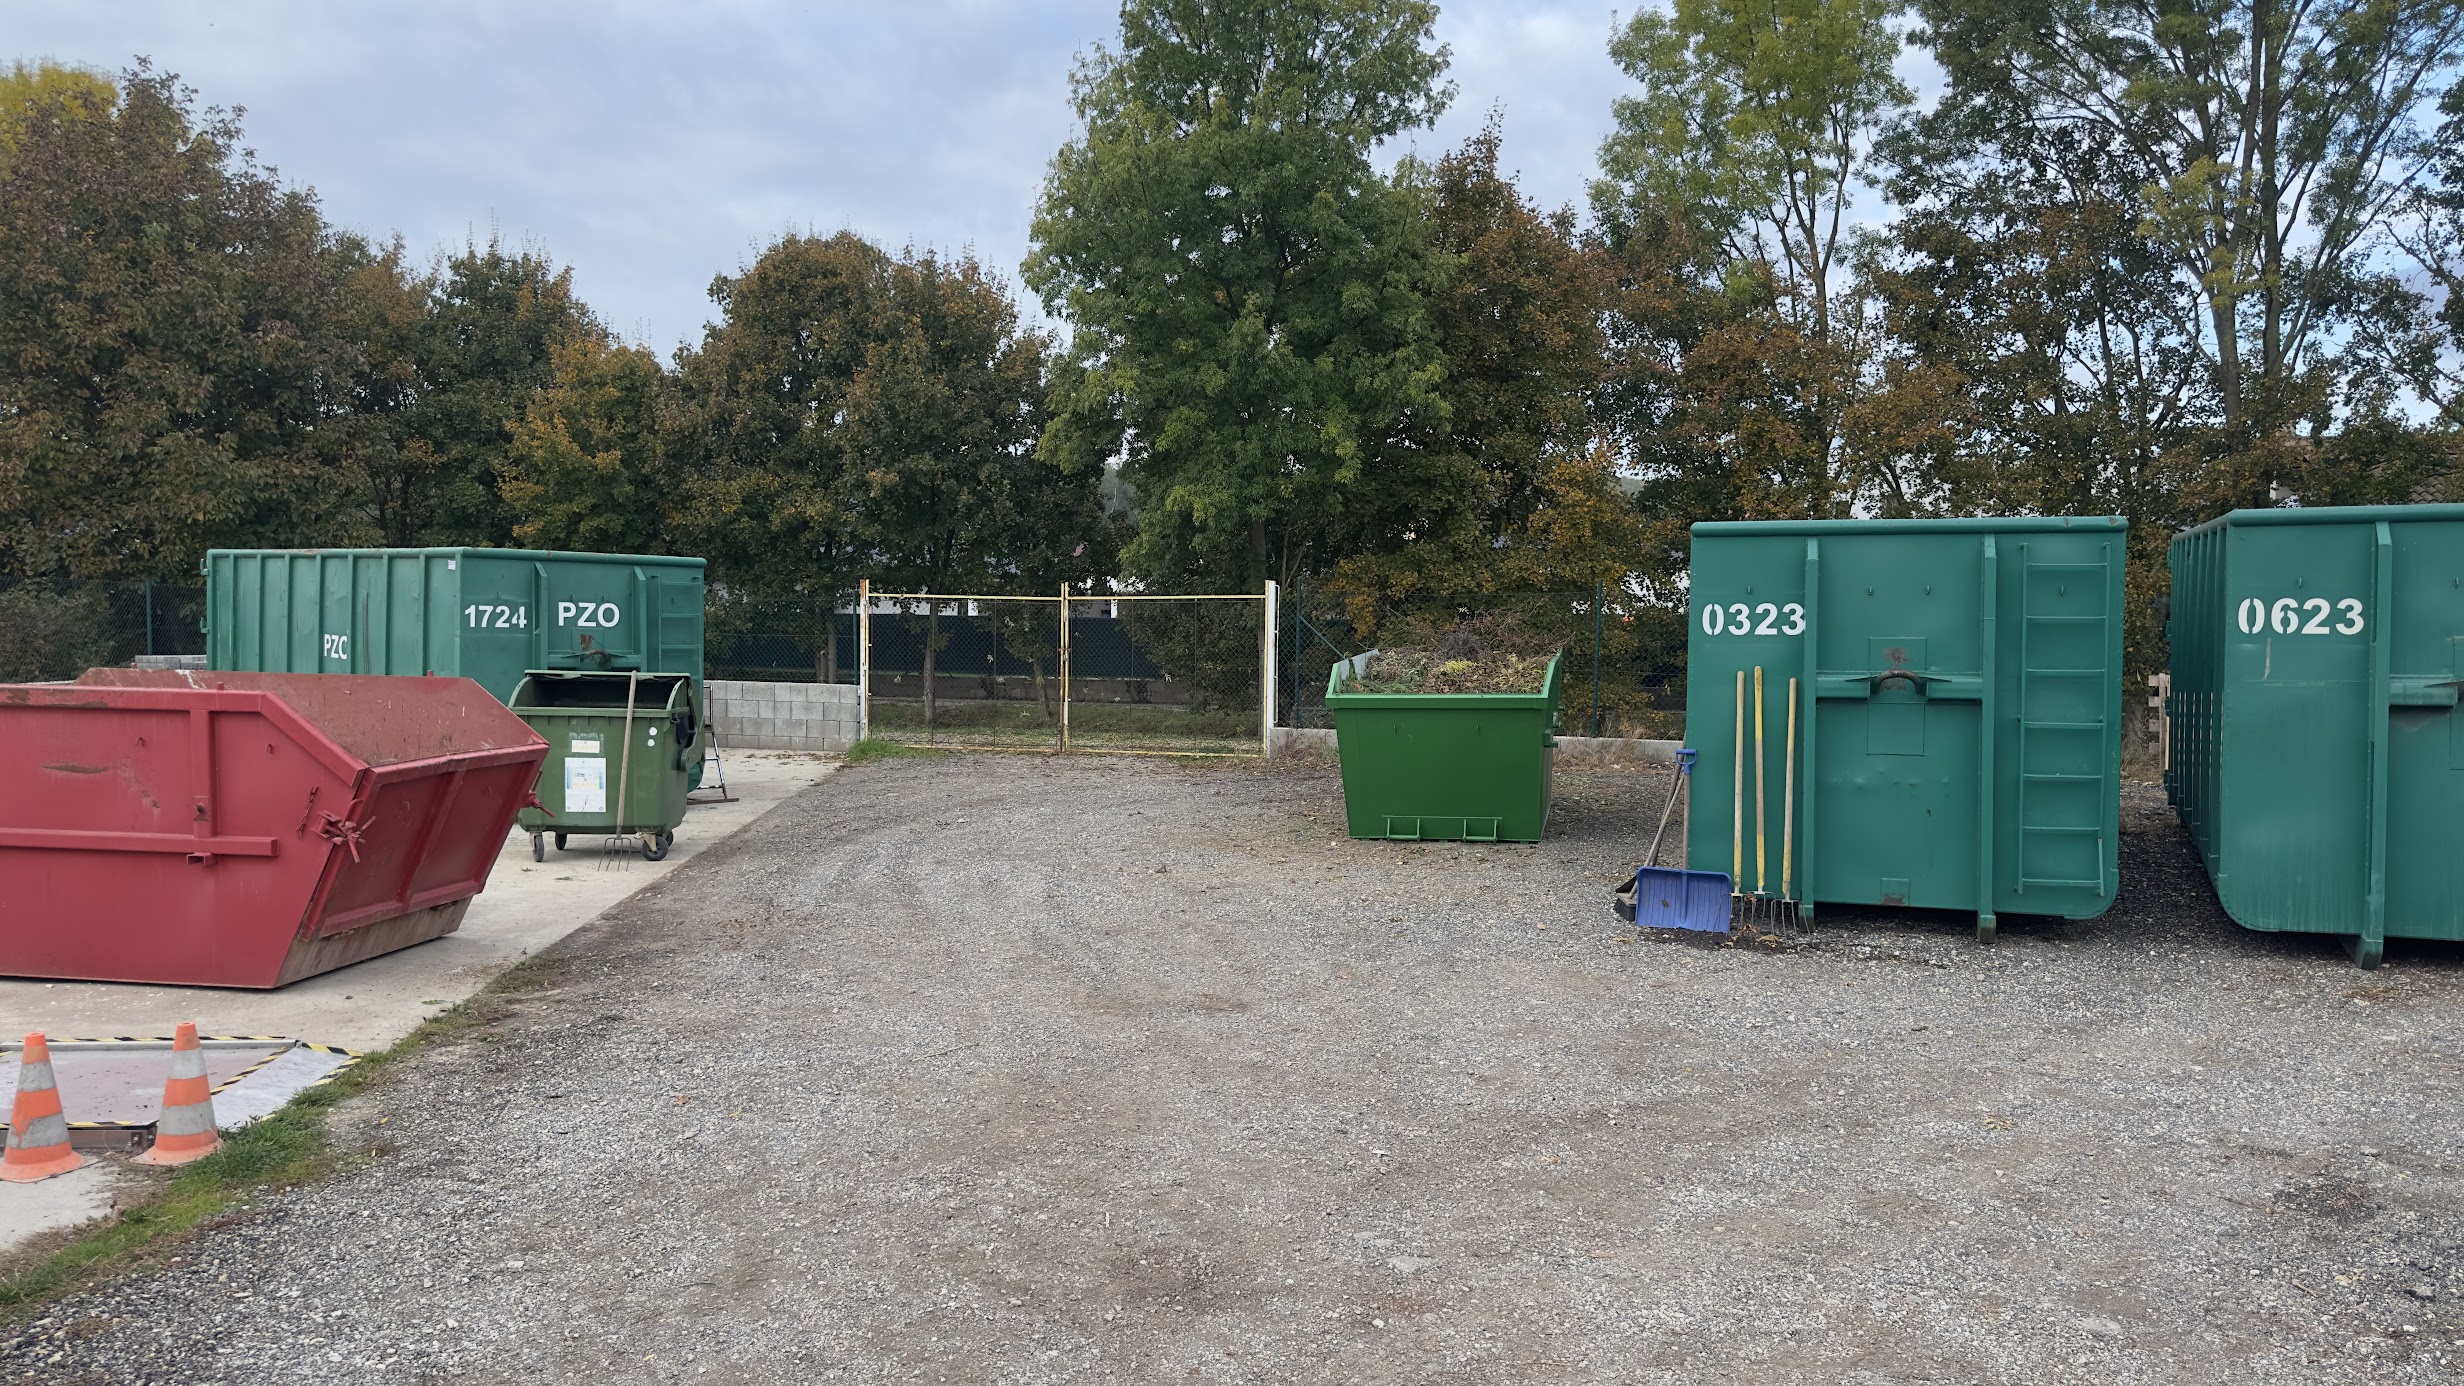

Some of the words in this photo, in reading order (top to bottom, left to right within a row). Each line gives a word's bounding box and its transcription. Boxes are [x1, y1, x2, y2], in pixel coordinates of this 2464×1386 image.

[464, 604, 528, 629] 1724
[558, 601, 620, 628] PZO
[1702, 602, 1806, 636] 0323
[2237, 597, 2365, 635] 0623
